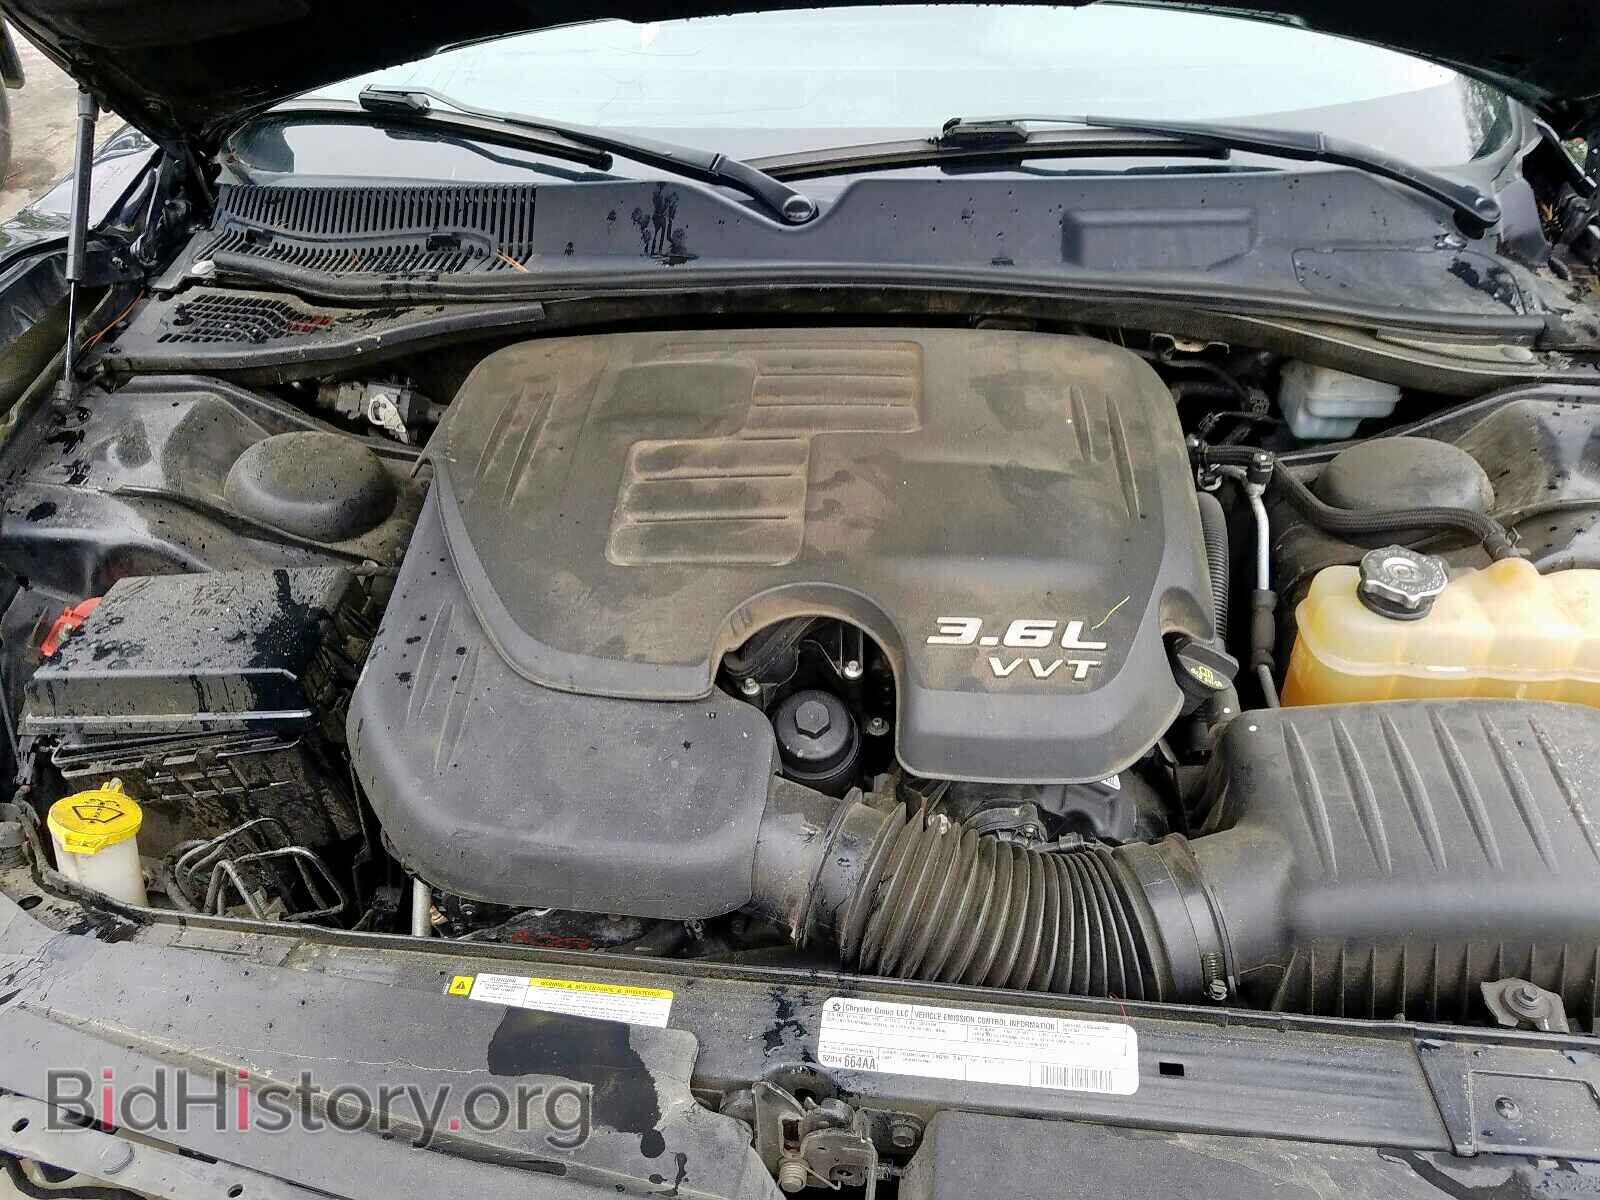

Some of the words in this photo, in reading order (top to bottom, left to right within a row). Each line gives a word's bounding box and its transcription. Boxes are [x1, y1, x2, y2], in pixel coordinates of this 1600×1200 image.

[926, 616, 1108, 650] 3.6L
[988, 657, 1102, 681] VVT
[896, 1008, 909, 1018] LLC
[914, 1009, 942, 1020] VEHICLE
[943, 1012, 976, 1024] EMISSION
[977, 1016, 1008, 1026] CONTROL
[1009, 1019, 1055, 1031] INFORMATION
